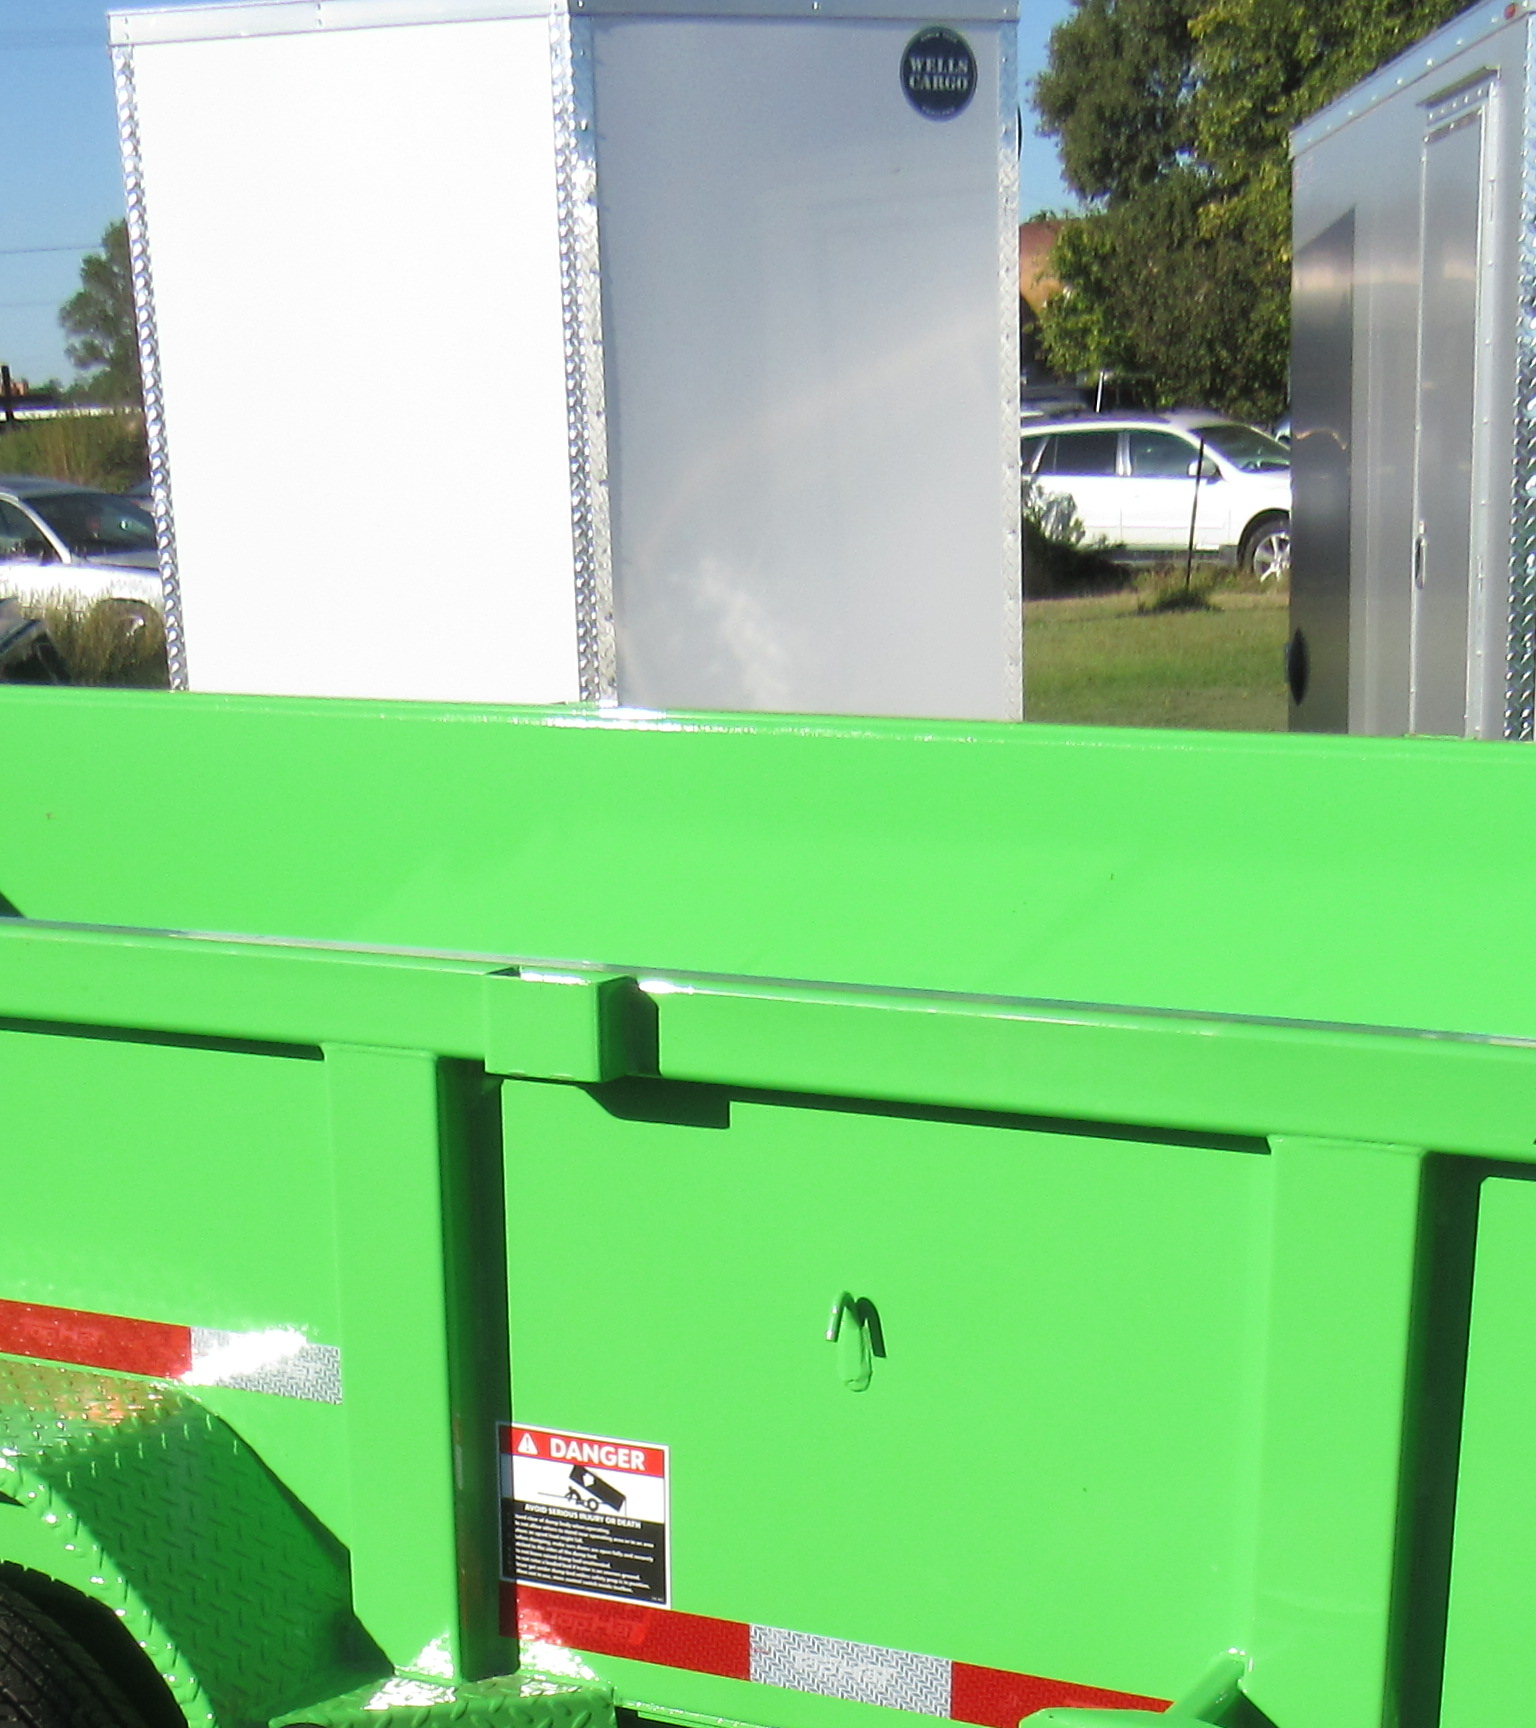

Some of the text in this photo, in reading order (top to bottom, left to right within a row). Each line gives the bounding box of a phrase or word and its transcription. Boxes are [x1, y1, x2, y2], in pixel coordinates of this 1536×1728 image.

[549, 1437, 645, 1471] DANGER
[524, 1503, 547, 1513] AVOID
[548, 1507, 578, 1518] SERIOUS
[578, 1512, 603, 1522] INJURY
[605, 1516, 615, 1524] OR
[617, 1518, 641, 1528] DEATH
